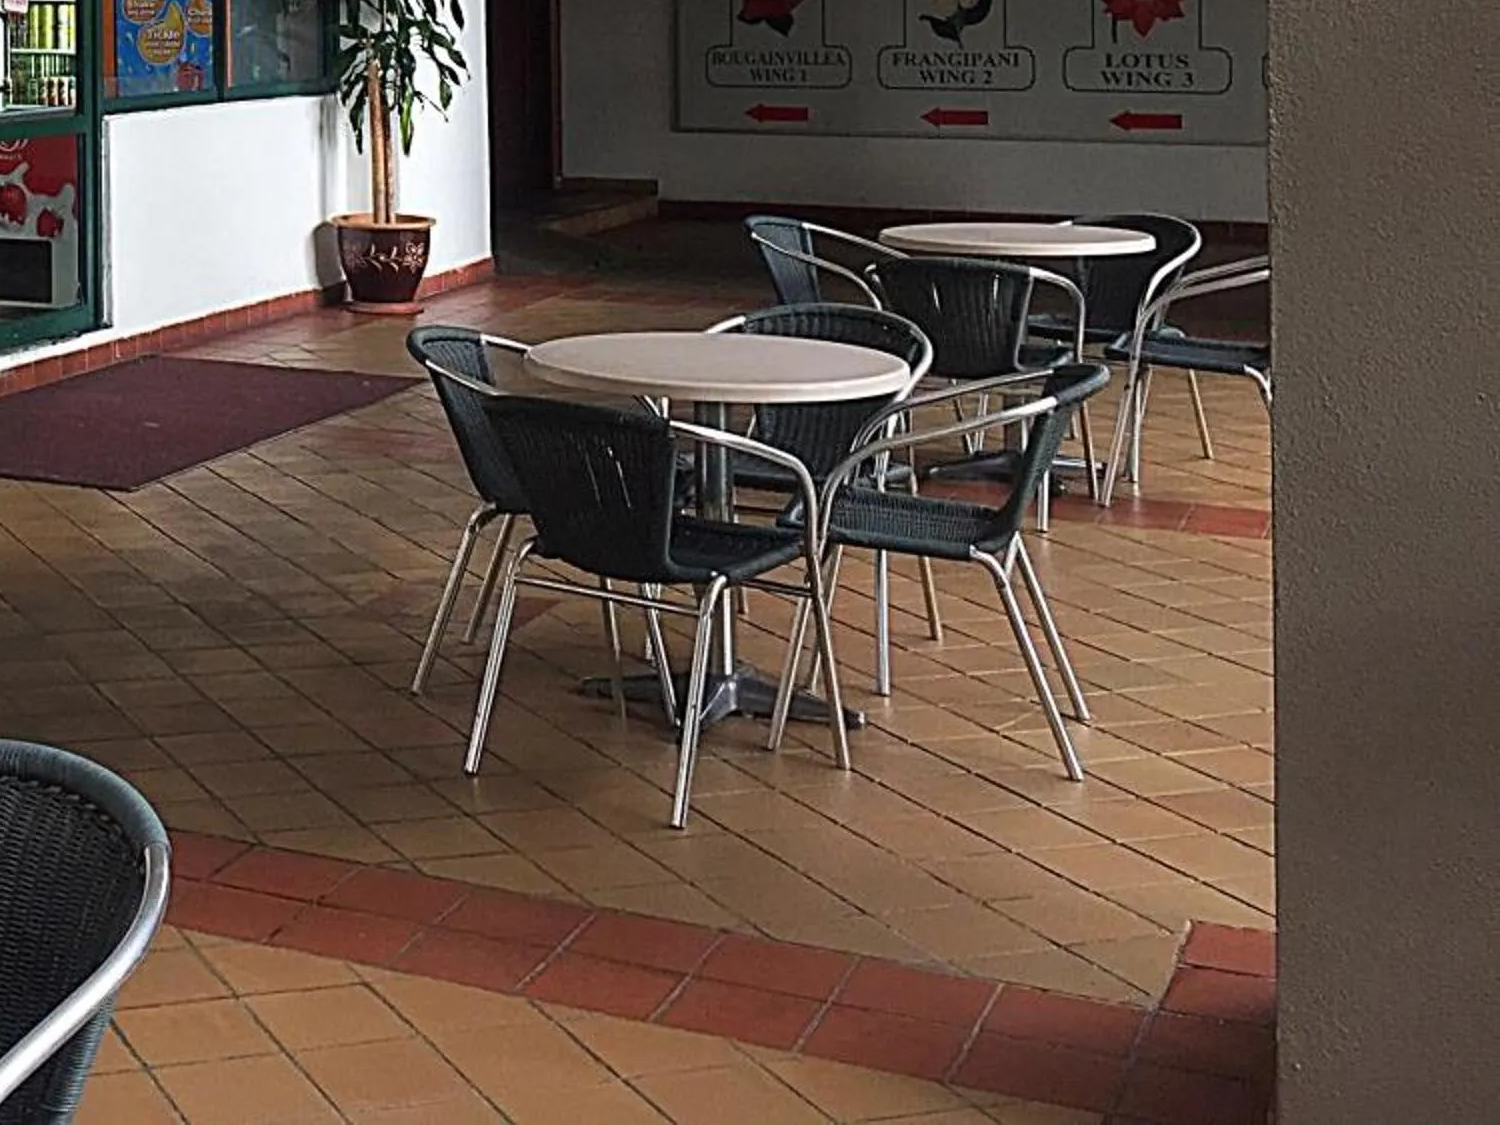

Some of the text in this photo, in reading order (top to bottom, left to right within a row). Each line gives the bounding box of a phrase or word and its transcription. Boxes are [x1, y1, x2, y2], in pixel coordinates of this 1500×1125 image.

[712, 50, 847, 67] BOUGAINVILLEA
[892, 51, 1020, 69] FRANGIPANI
[1105, 52, 1190, 70] LOTUS
[749, 67, 795, 83] WING
[918, 69, 995, 85] WING 2
[1100, 70, 1196, 88] WING 3
